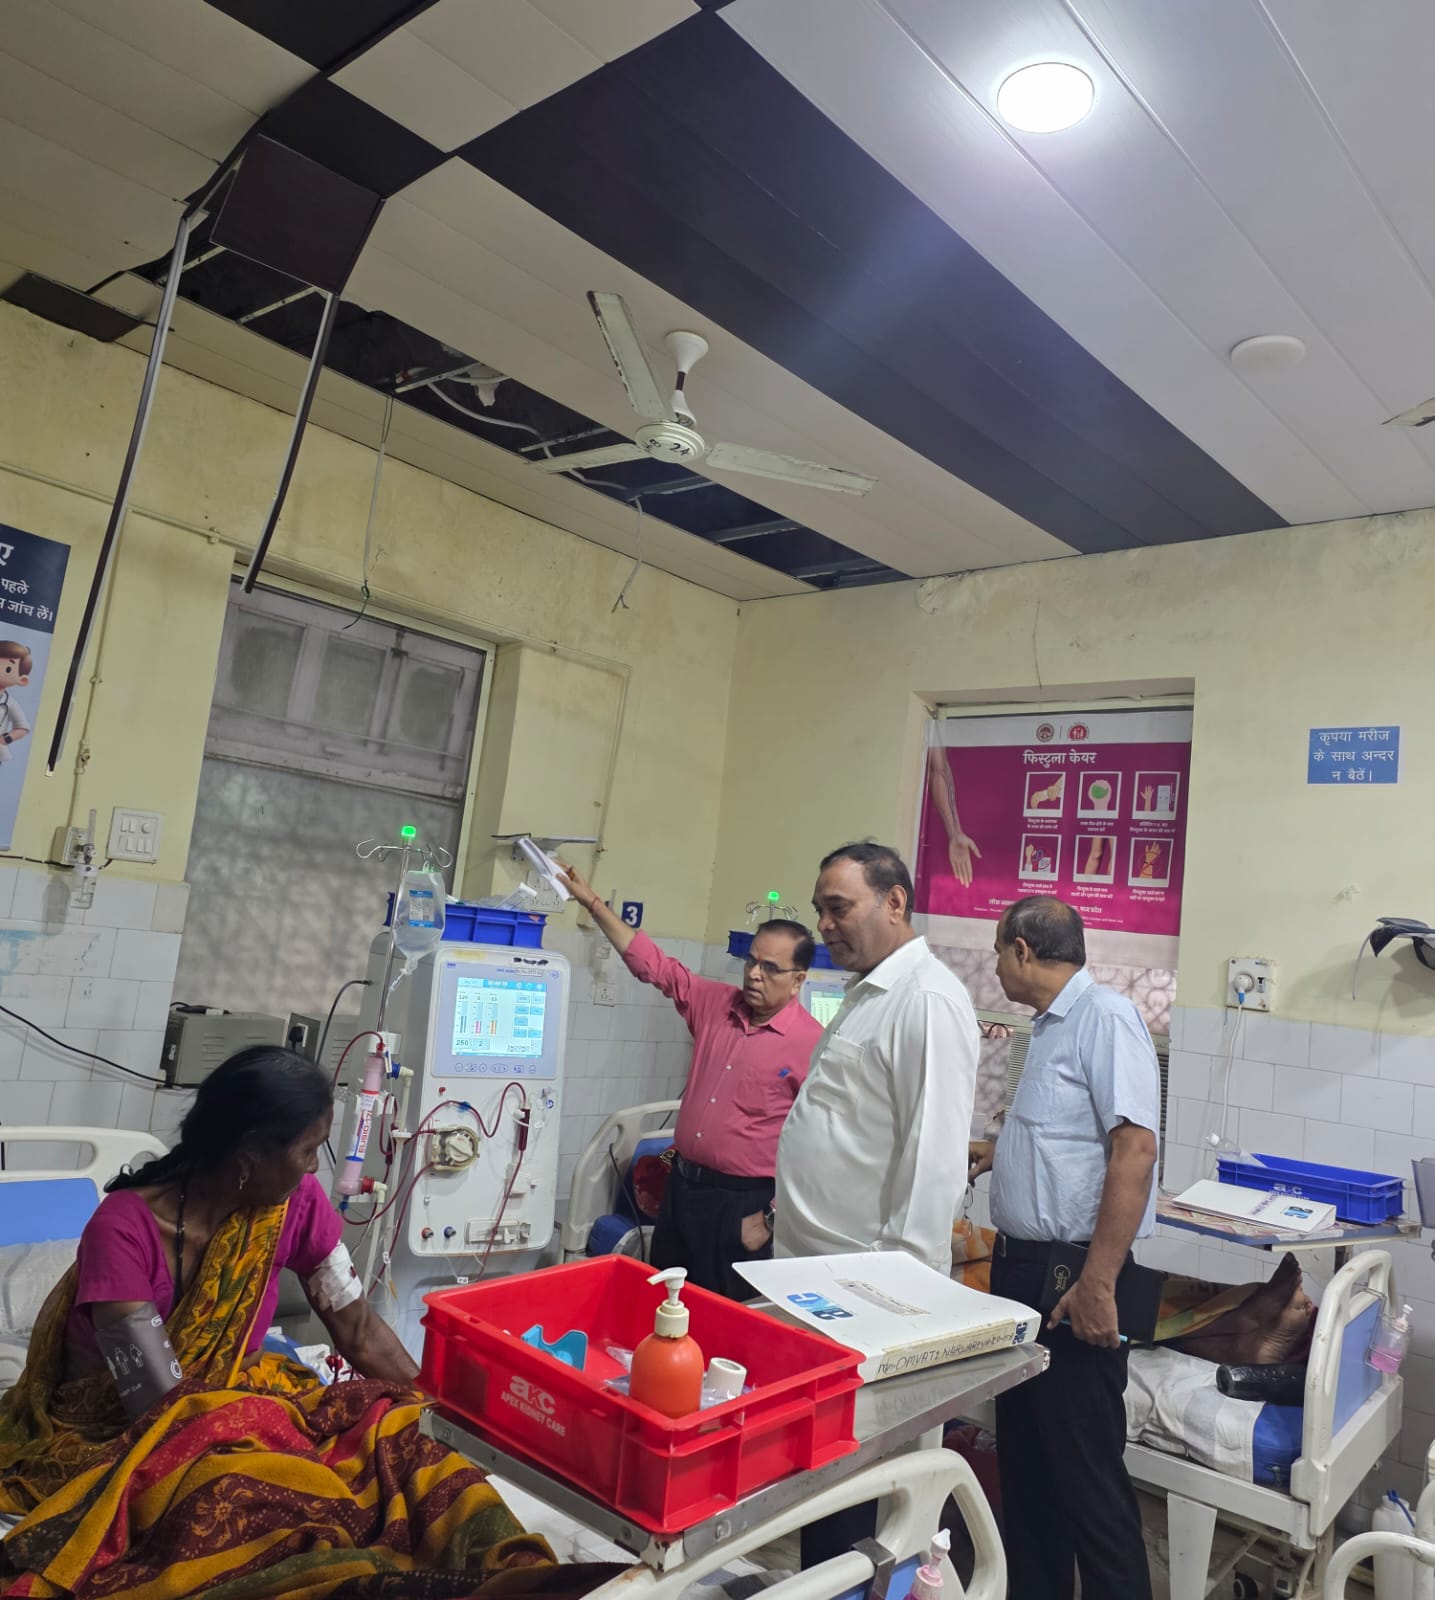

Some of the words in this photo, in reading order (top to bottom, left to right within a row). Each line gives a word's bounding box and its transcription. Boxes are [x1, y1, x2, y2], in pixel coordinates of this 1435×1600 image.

[1, 578, 30, 595] पहले
[7, 600, 35, 616] जांच
[36, 605, 54, 621] लें।
[1318, 731, 1352, 746] कृपया
[1358, 728, 1391, 741] मरीज
[1022, 749, 1067, 768] फिस्टुला
[1068, 748, 1097, 764] केयर
[1312, 749, 1325, 762] के
[1330, 751, 1357, 762] साथ
[1361, 750, 1395, 761] अन्दर
[1331, 770, 1341, 781] न
[625, 905, 638, 926] 3
[455, 1039, 469, 1047] 250
[501, 1391, 520, 1410] APEX
[519, 1400, 546, 1425] KIDNEY
[546, 1418, 566, 1438] CARE
